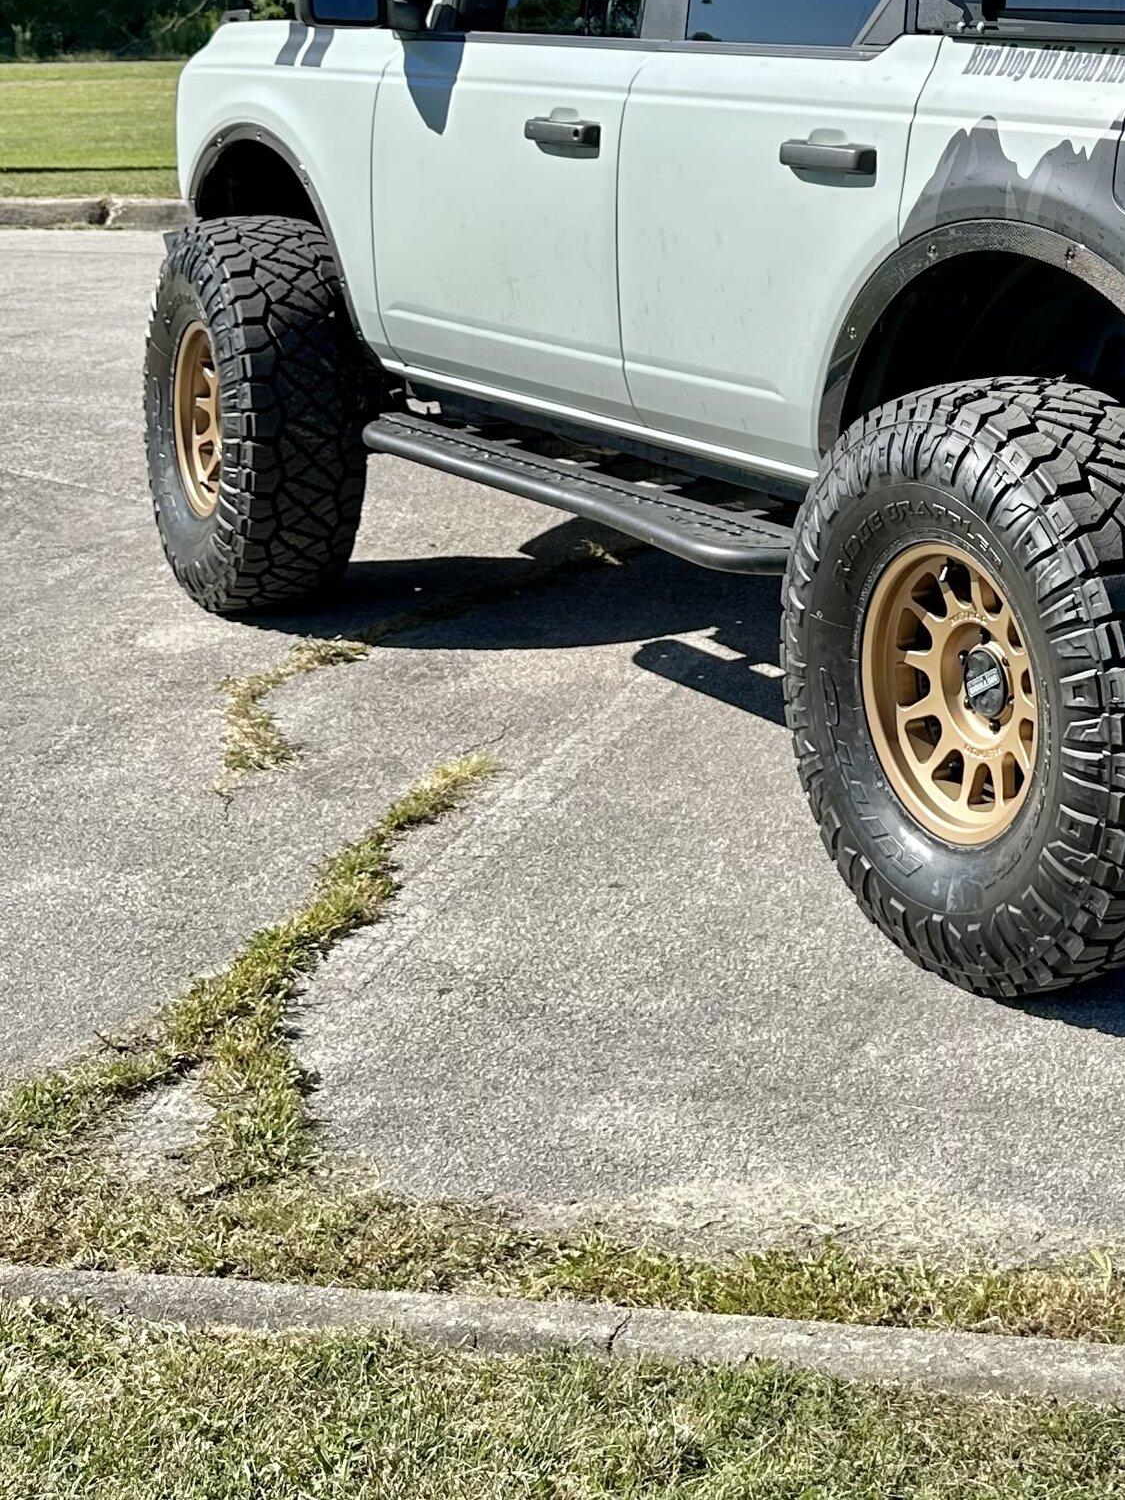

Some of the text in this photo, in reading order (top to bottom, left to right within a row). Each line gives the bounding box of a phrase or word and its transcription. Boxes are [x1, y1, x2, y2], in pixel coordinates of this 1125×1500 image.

[961, 42, 1006, 76] Bird
[997, 43, 1036, 82] Dog
[1029, 44, 1064, 79] Off
[1053, 46, 1106, 82] Road
